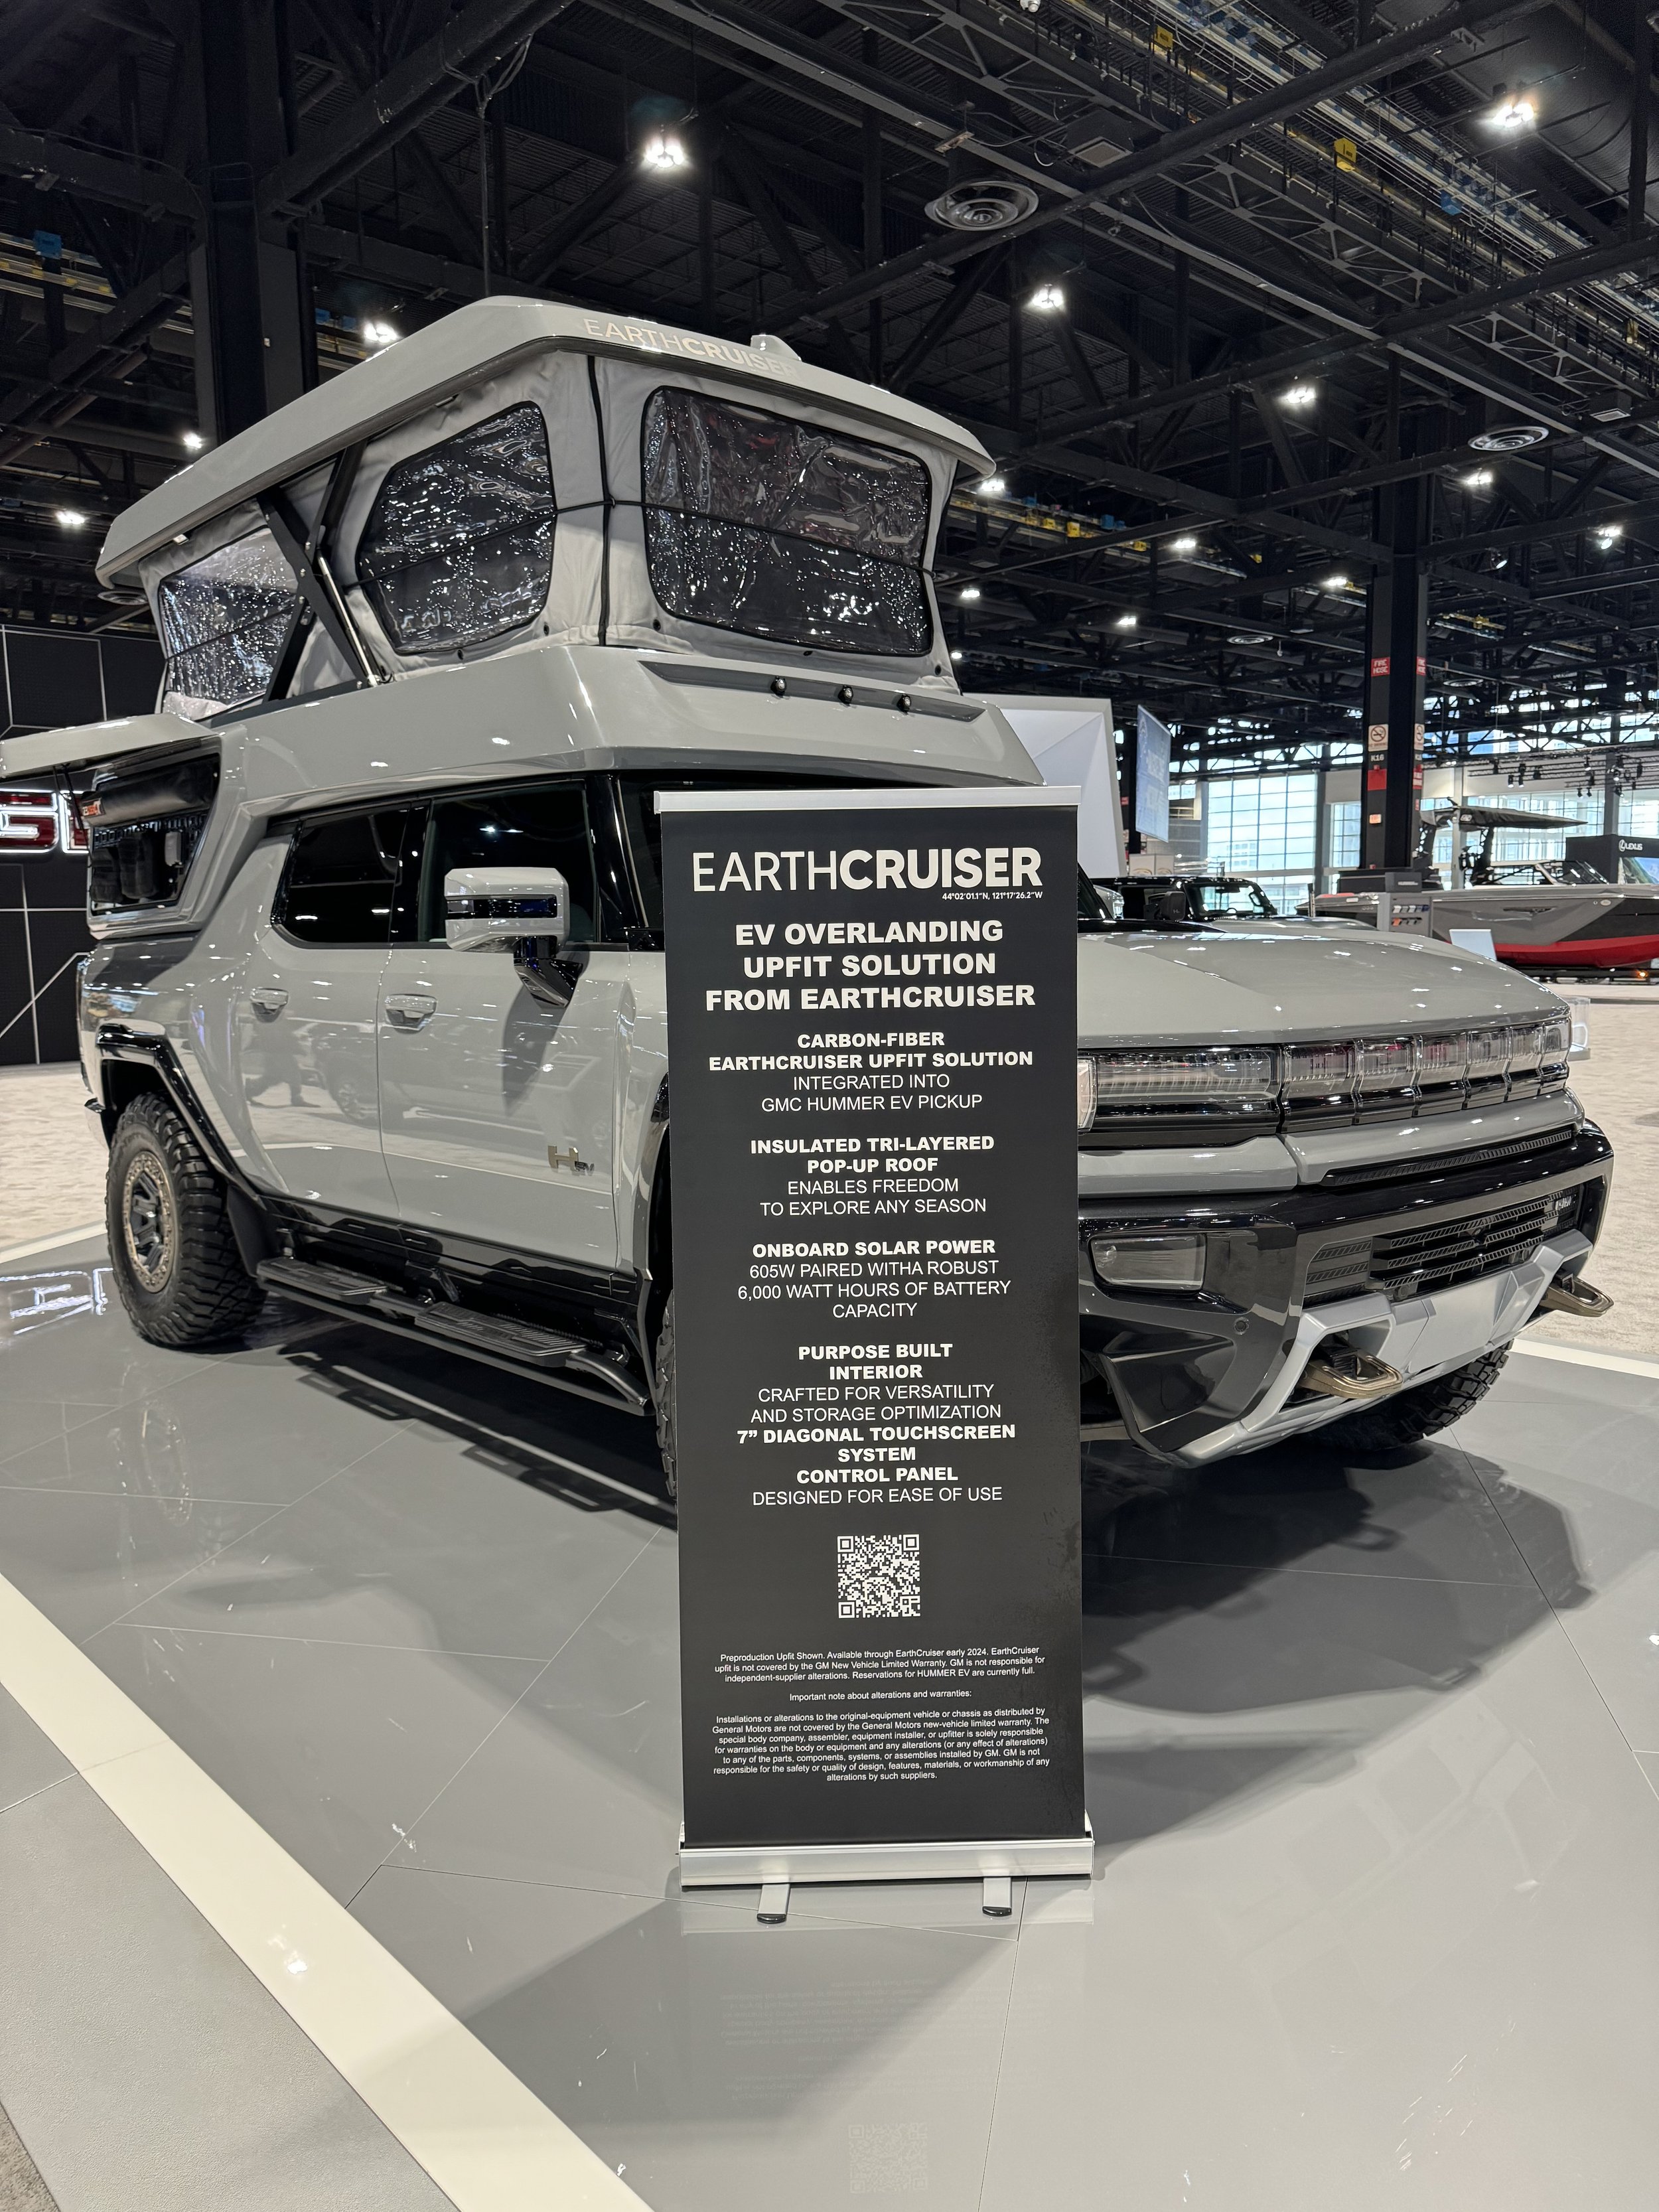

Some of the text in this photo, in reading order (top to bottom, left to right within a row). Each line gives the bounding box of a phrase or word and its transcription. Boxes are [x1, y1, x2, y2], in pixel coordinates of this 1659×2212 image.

[583, 318, 802, 381] EARTHCRUISER
[693, 847, 1043, 891] EARTHCRUISER
[736, 920, 1003, 946] EV OVERLANDING
[744, 953, 995, 978] UPFIT SOLUTION
[706, 985, 1035, 1011] FROM EARTHCRUISER
[798, 1032, 945, 1049] CARBON-FIBER
[709, 1051, 1033, 1071] EARTHCRUISER UPFIT SOLUTION
[794, 1073, 950, 1090] INTEGRATED INTO
[762, 1094, 982, 1112] GMC HUMMER EV PICKUP
[751, 1136, 994, 1154] INSULATED TRI-LAYERED
[808, 1157, 938, 1174] POP-UP ROOF
[788, 1178, 958, 1195] ENABLES FREEDOM
[760, 1198, 985, 1216] TO EXPLORE ANY SEASON
[753, 1240, 995, 1258] ONBOARD SOLAR POWER
[750, 1264, 795, 1279] 605W
[800, 1263, 863, 1278] PAIRED
[928, 1260, 999, 1275] ROBUST
[738, 1280, 1011, 1301] 6,000 WATT HOURS OF BATTERY
[833, 1303, 917, 1318] CAPACITY
[799, 1343, 953, 1360] PURPOSE BUILT
[830, 1364, 923, 1380] INTERIOR
[758, 1384, 994, 1402] CRAFTED FOR VERSATILITY
[751, 1404, 1001, 1423] AND STORAGE OPTIMIZATION
[764, 1428, 864, 1443] DIAGONAL
[869, 1424, 1015, 1441] TOUCHSCREEN
[838, 1447, 916, 1463] SYSTEM
[797, 1467, 958, 1484] CONTROL PANEL
[753, 1487, 1002, 1506] DESIGNED FOR EASE OF USE
[721, 1653, 774, 1663] Preproduction
[776, 1652, 795, 1662] Upfit
[827, 1651, 862, 1659] Available
[864, 1650, 894, 1660] through
[896, 1649, 944, 1657] EarthCruiser
[946, 1649, 966, 1658] early
[991, 1646, 1039, 1655] EarthCruiser
[715, 1664, 732, 1674] upfit
[757, 1662, 787, 1671] covered
[789, 1662, 799, 1672] by
[815, 1661, 829, 1670] GM
[851, 1660, 879, 1669] Vehicle
[911, 1659, 948, 1668] Warranty.
[989, 1657, 1033, 1666] responsible
[725, 1672, 806, 1684] independent-supplier
[852, 1670, 902, 1679] Reservations
[987, 1667, 1020, 1676] currently
[790, 1693, 826, 1702] Important
[871, 1690, 911, 1699] alterations
[913, 1690, 928, 1698] and
[930, 1689, 972, 1698] warranties:
[716, 1715, 762, 1724] Installations
[774, 1714, 814, 1722] alterations
[826, 1712, 838, 1721] the
[839, 1711, 911, 1722] original-equipment
[952, 1709, 981, 1718] chassis
[994, 1707, 1034, 1716] distributed
[1036, 1707, 1045, 1716] by
[719, 1735, 746, 1745] special
[748, 1735, 767, 1745] body
[808, 1733, 849, 1741] assembler,
[851, 1732, 893, 1741] equipment
[895, 1731, 926, 1739] installer,
[938, 1730, 965, 1739] upfitter
[975, 1729, 997, 1739] solely
[999, 1727, 1043, 1737] responsible
[713, 1765, 758, 1775] responsible
[786, 1764, 810, 1773] safety
[822, 1763, 847, 1773] quality
[858, 1762, 886, 1772] design,
[924, 1760, 962, 1769] materials,
[974, 1758, 1025, 1767] workmanship
[1026, 1757, 1034, 1766] of
[827, 1773, 867, 1781] alterations
[869, 1773, 878, 1782] by
[901, 1771, 937, 1781] suppliers.
